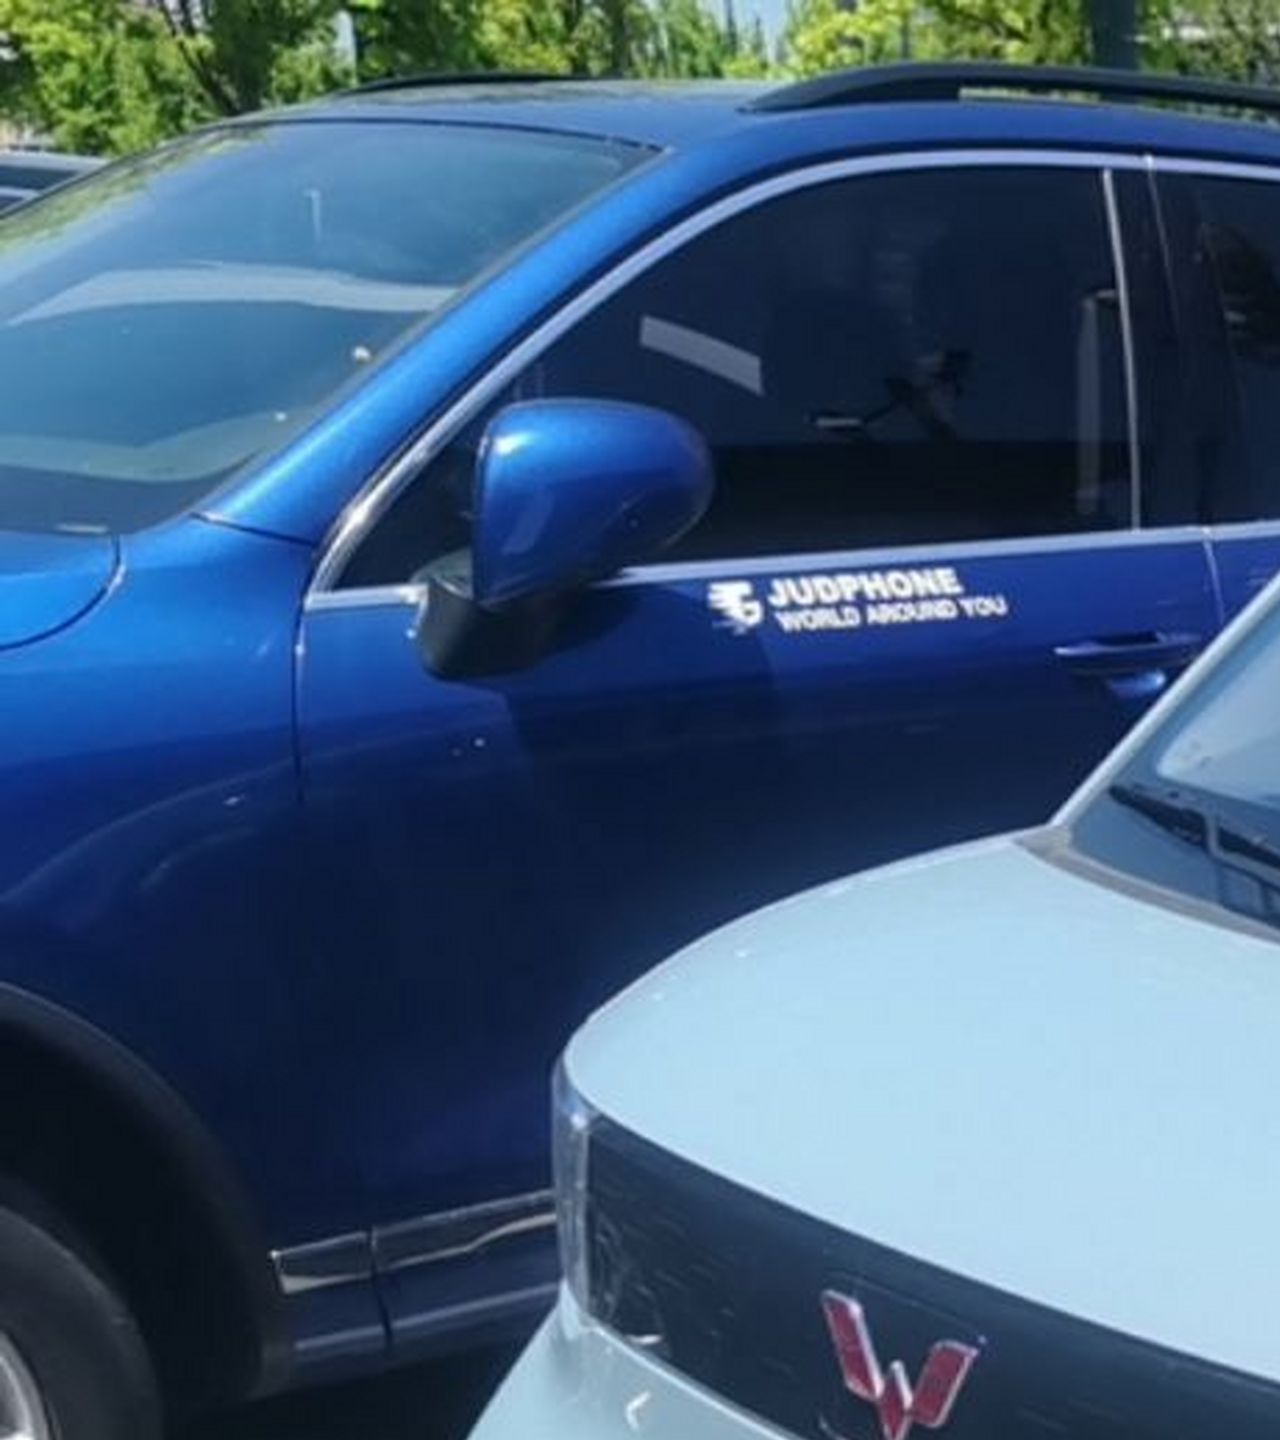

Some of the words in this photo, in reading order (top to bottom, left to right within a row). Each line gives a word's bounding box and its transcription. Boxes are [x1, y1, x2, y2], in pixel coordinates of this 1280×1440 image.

[767, 566, 963, 608] JUDPHONE
[774, 602, 861, 633] WORLD
[866, 598, 957, 626] AROUND
[957, 595, 1009, 618] YOU
